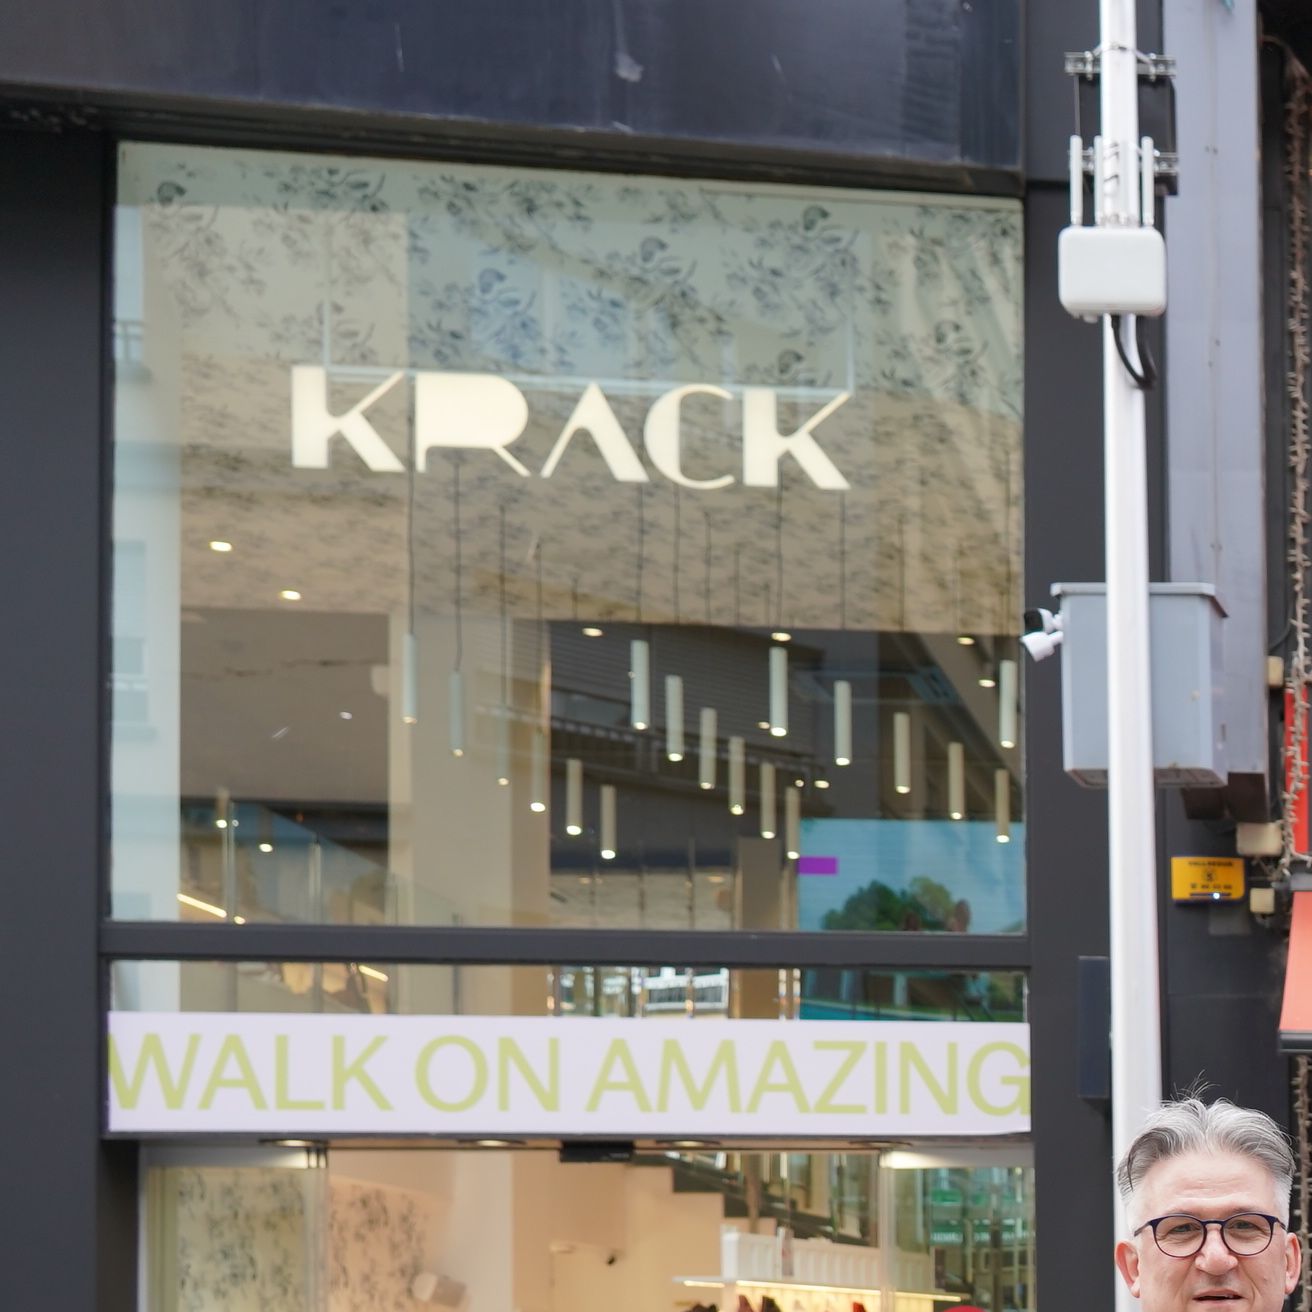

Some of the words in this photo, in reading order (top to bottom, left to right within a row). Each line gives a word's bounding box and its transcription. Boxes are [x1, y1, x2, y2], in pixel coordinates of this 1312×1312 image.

[290, 365, 852, 491] KRACK
[107, 1033, 395, 1112] WALK
[414, 1034, 560, 1113] ON
[586, 1039, 1031, 1117] AMAZING
